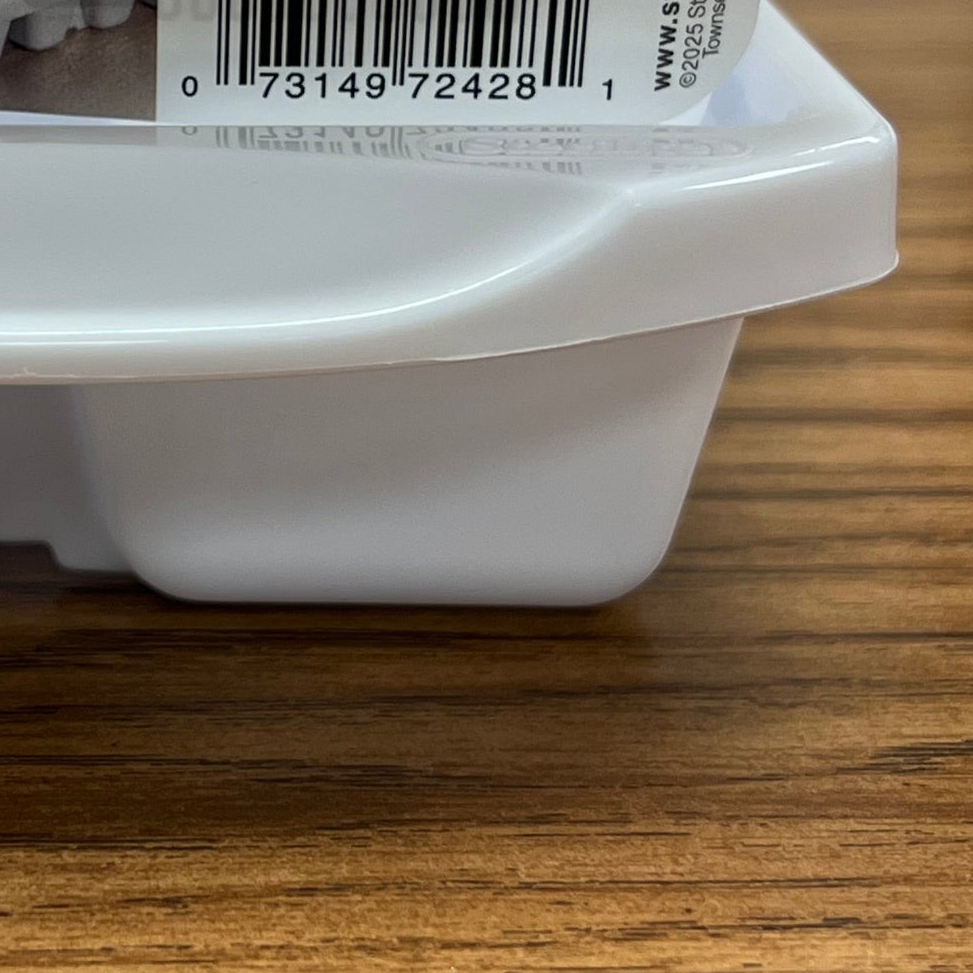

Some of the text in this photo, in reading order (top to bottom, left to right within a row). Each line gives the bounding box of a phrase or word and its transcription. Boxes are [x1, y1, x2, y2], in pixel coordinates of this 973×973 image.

[679, 23, 703, 88] ©2025
[181, 72, 613, 101] 0 73149 72428 1
